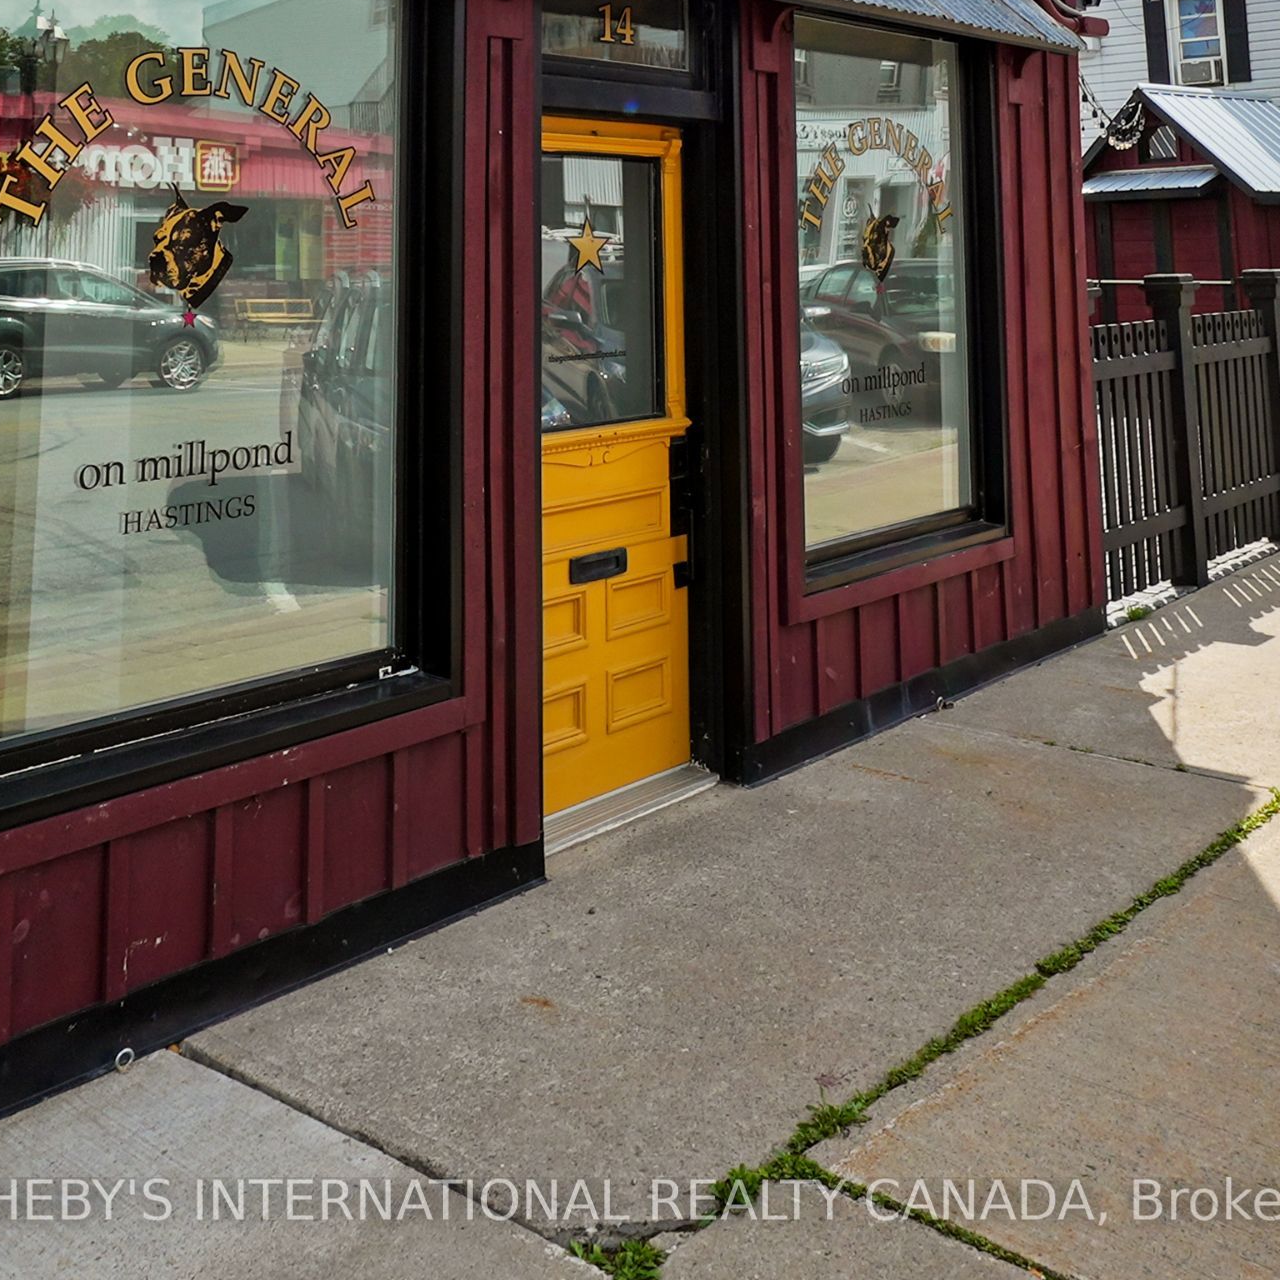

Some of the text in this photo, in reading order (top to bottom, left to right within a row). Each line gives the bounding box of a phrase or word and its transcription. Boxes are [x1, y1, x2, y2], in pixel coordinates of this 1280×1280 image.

[597, 3, 635, 45] 14
[126, 47, 376, 228] GENERAL
[800, 117, 954, 234] THE GENERAL
[842, 362, 926, 395] on millpond
[861, 404, 912, 423] HASTINGS
[79, 431, 293, 490] on millpond
[122, 495, 256, 535] HASTINGS
